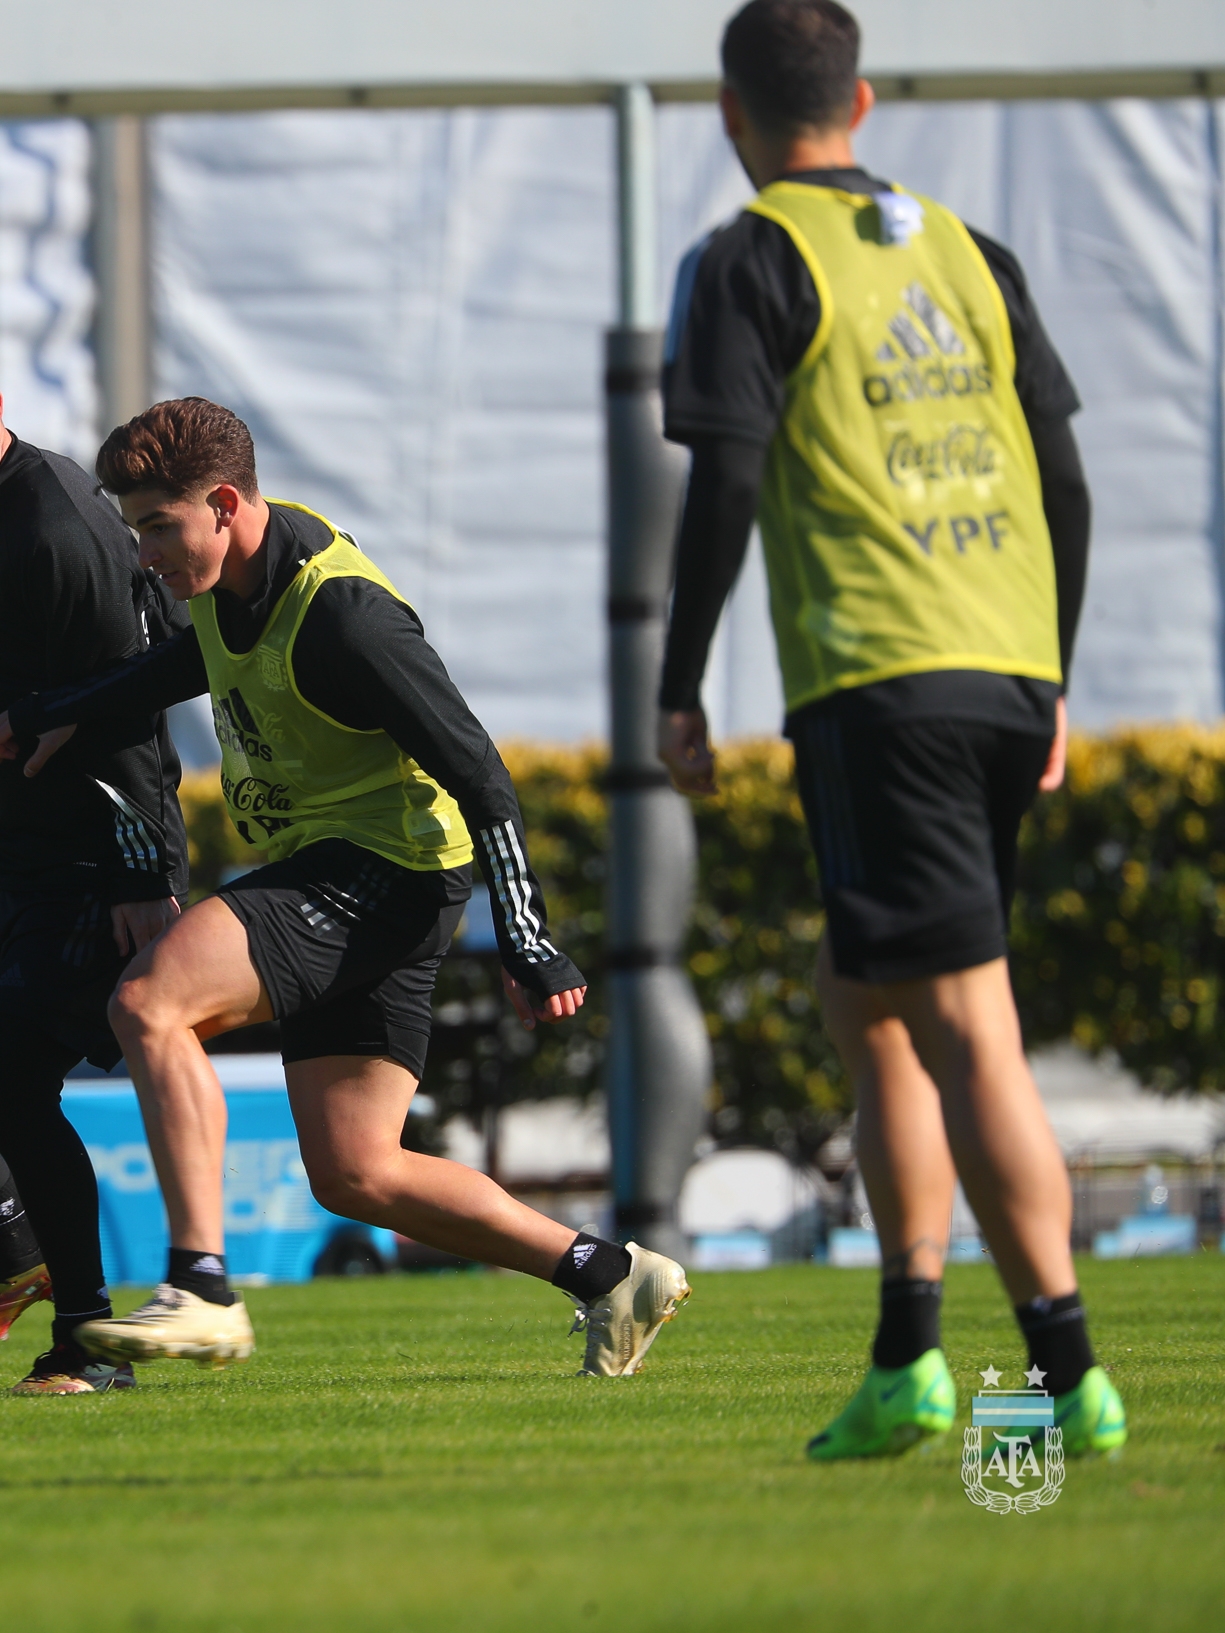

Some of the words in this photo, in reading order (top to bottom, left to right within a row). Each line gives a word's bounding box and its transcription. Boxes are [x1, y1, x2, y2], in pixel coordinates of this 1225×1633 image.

[862, 361, 992, 408] adidas
[902, 509, 1010, 557] YPF
[575, 1243, 598, 1270] adidas
